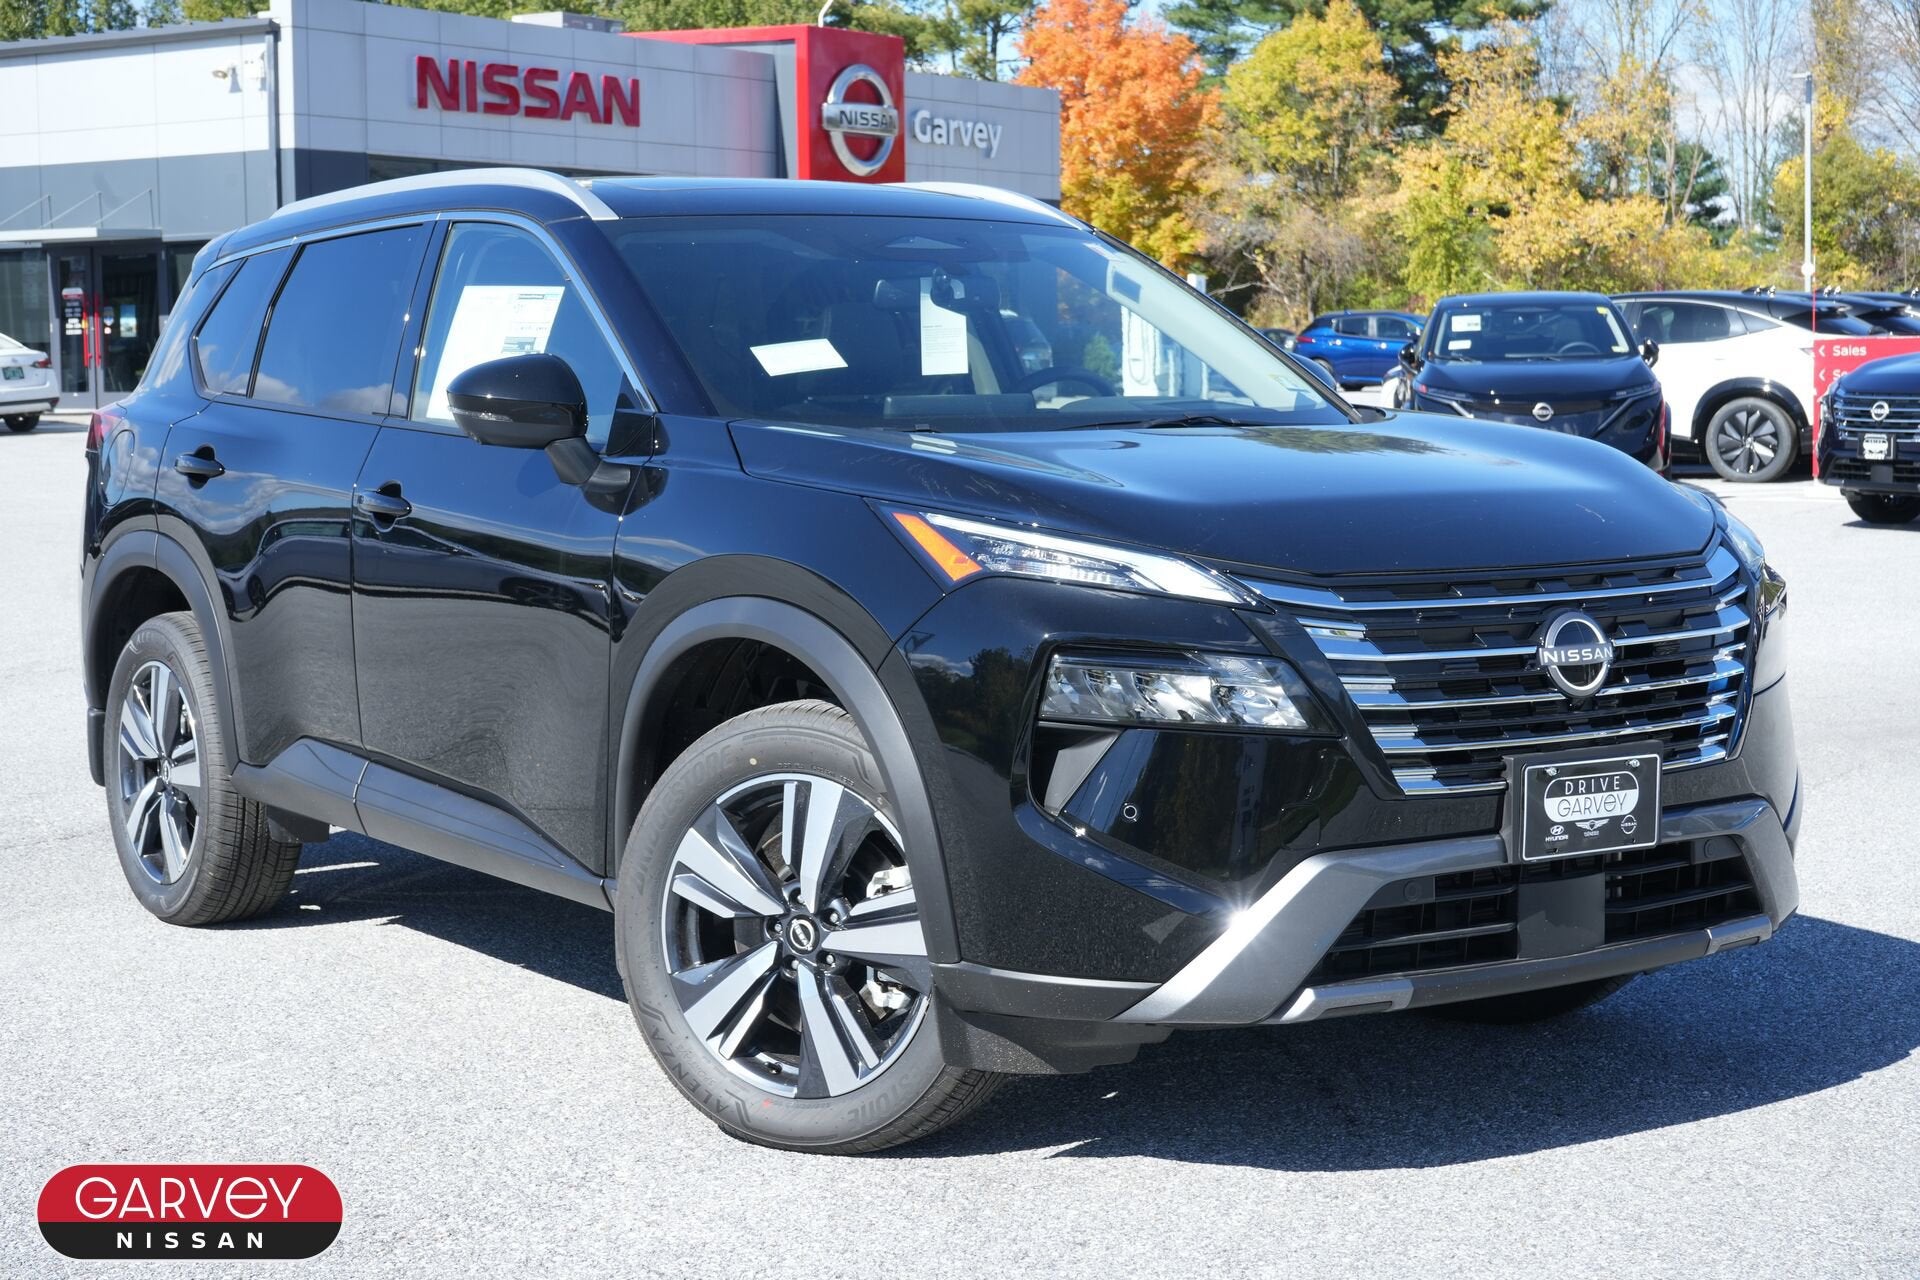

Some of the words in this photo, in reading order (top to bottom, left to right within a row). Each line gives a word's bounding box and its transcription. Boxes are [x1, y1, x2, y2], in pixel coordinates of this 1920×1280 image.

[416, 55, 640, 127] NISSAN
[839, 110, 897, 130] NISSAN
[914, 110, 1002, 159] Garvey
[1832, 345, 1867, 356] Sales
[1543, 646, 1613, 664] NISSAN
[1565, 776, 1620, 795] DRIVE
